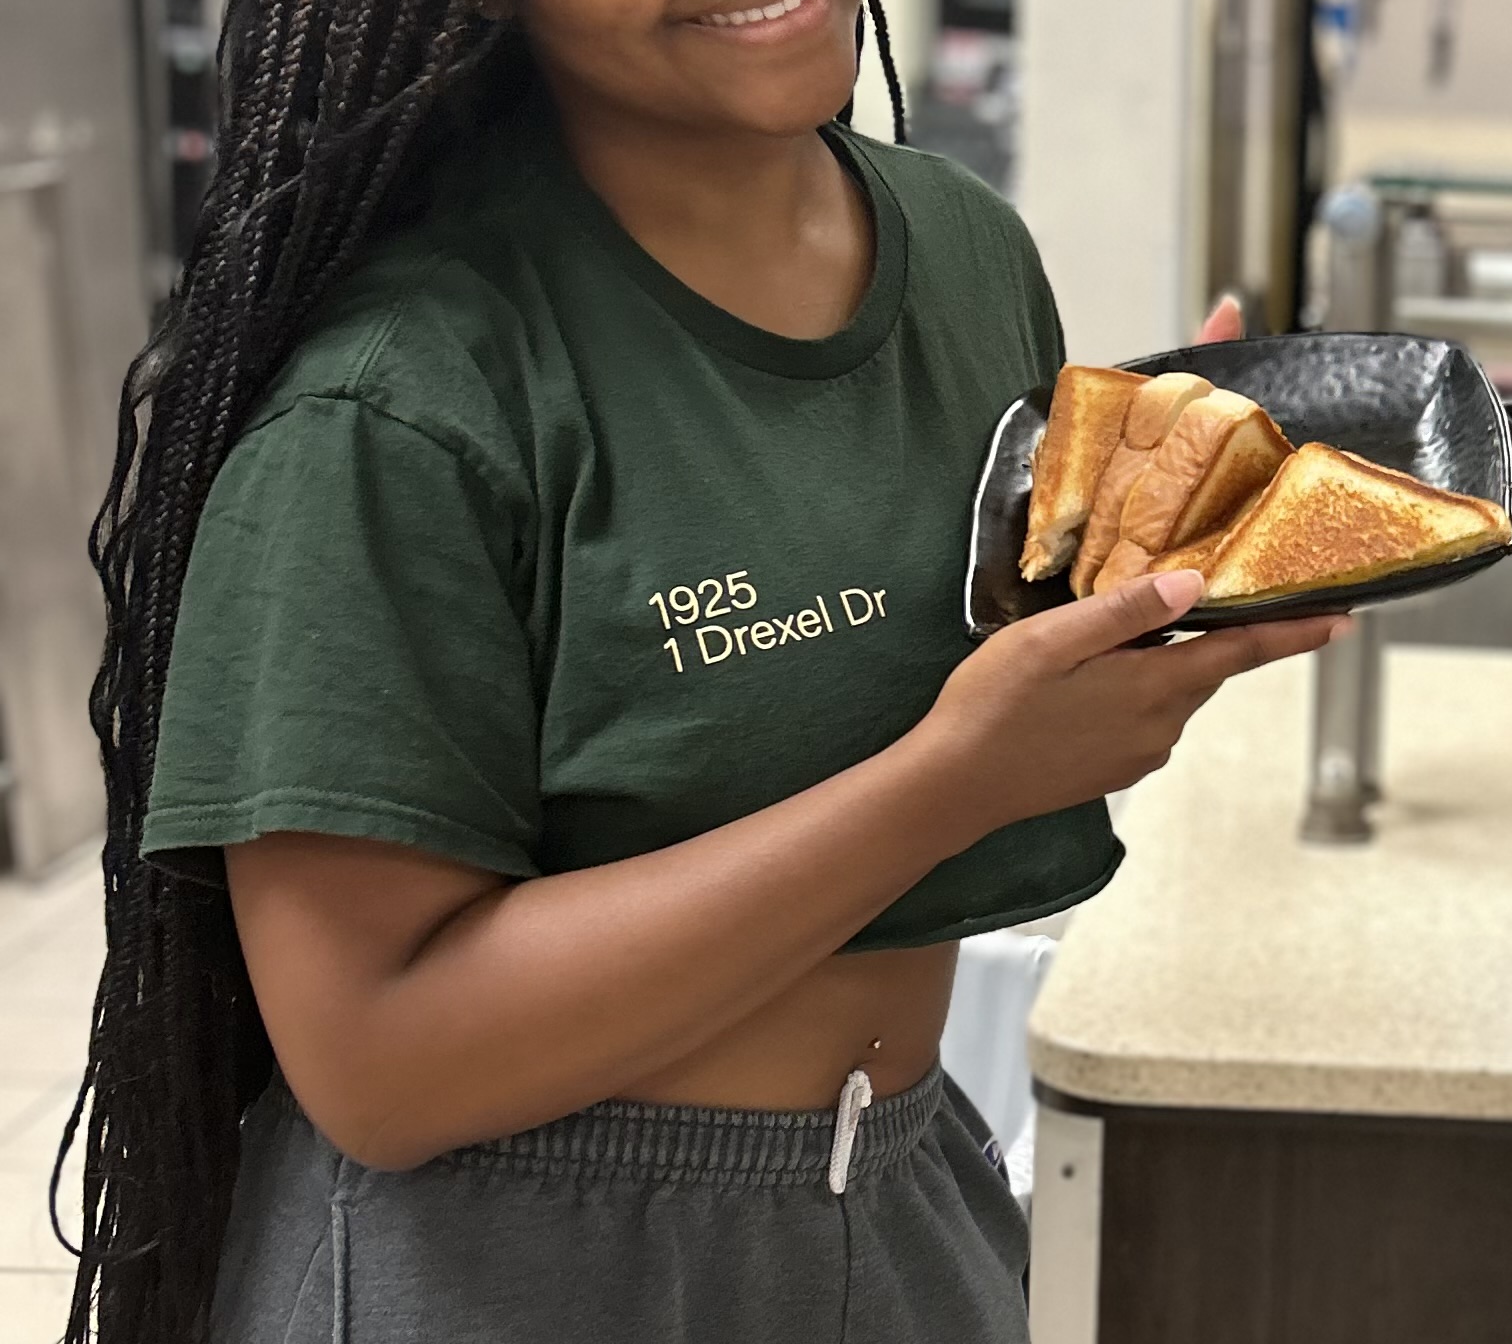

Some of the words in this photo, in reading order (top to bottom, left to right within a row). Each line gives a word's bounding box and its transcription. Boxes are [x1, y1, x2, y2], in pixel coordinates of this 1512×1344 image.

[648, 570, 758, 630] 1925
[663, 637, 684, 673] 1
[695, 595, 834, 665] Drexel
[839, 587, 887, 627] Dr
